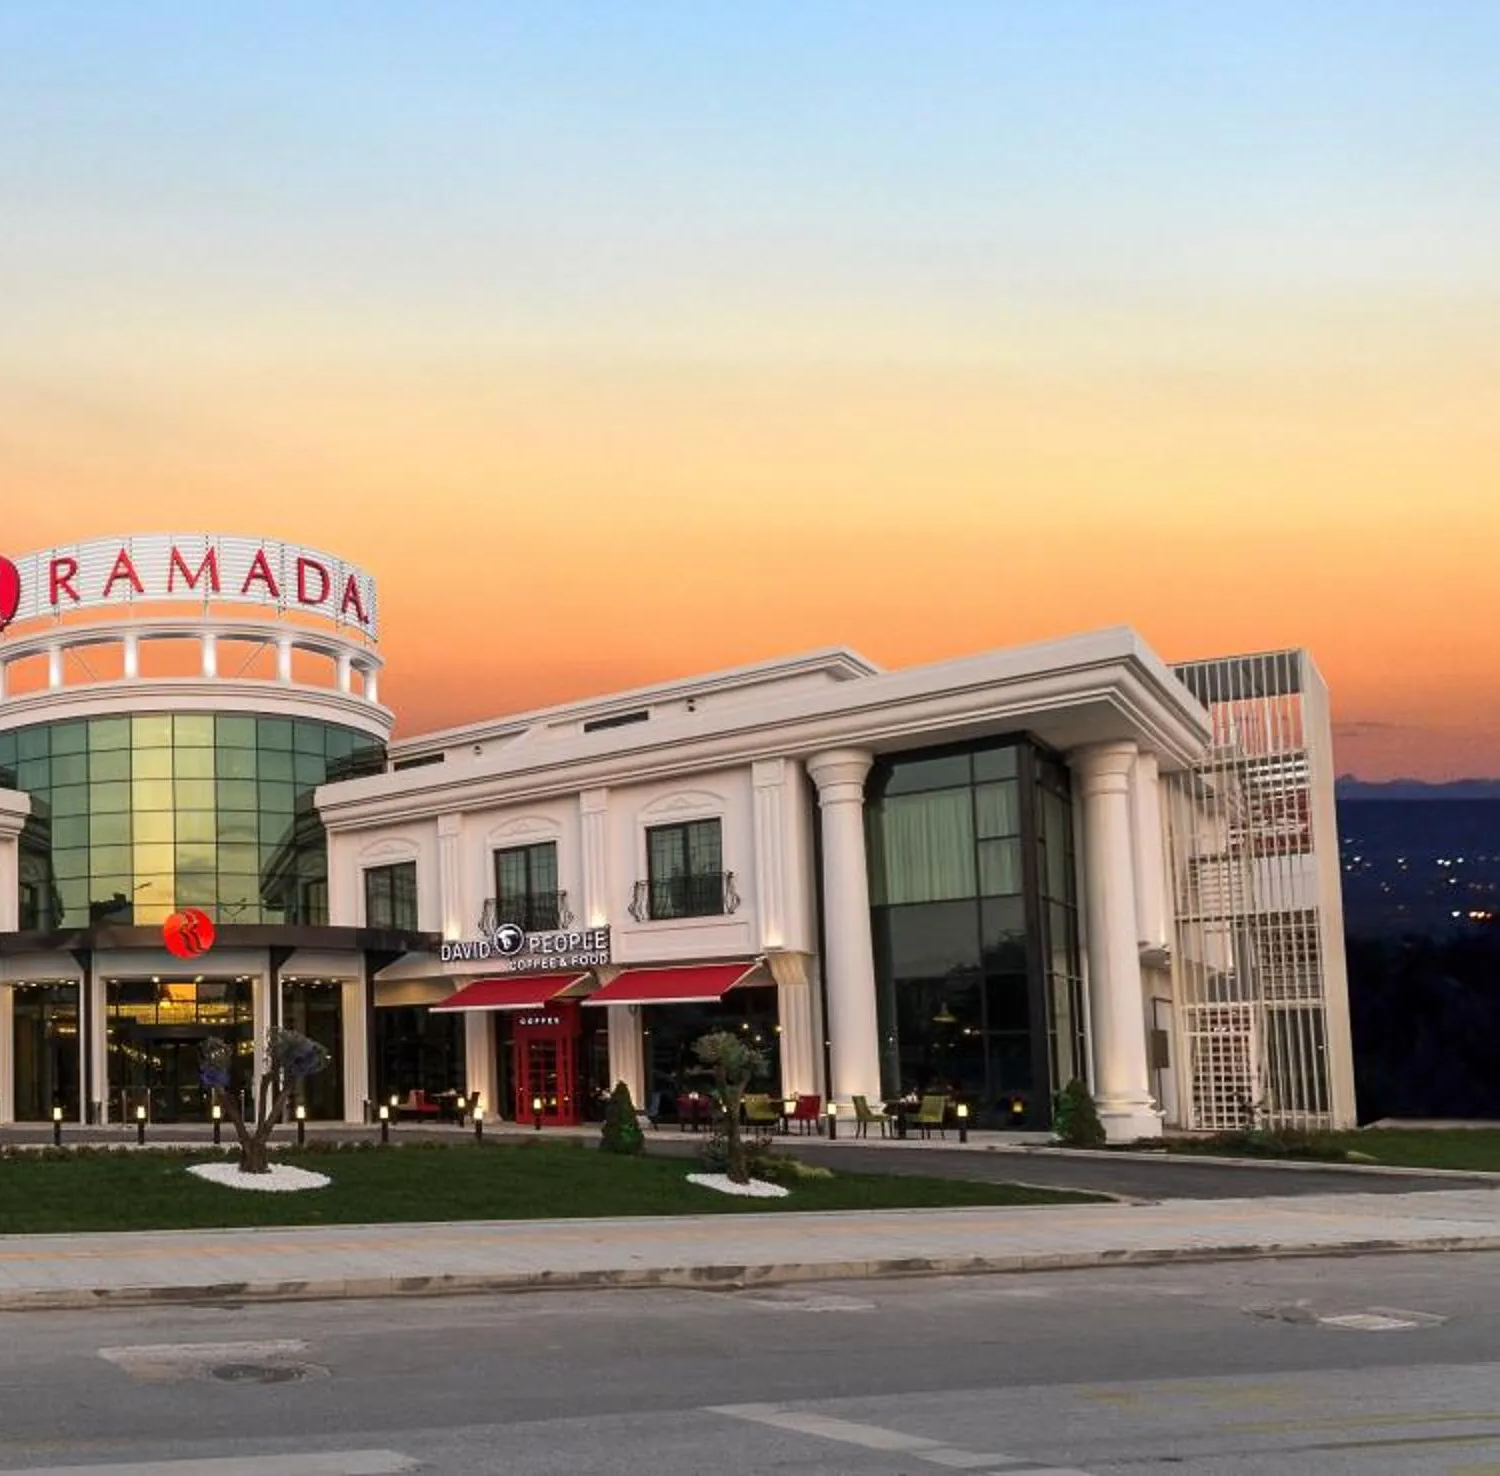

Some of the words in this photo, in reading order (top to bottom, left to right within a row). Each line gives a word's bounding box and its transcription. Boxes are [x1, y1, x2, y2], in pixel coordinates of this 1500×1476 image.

[441, 941, 490, 961] DAVID
[528, 930, 607, 953] PEOPLE
[509, 957, 557, 971] COFFEE
[559, 956, 567, 967] &
[571, 952, 609, 966] FOOD
